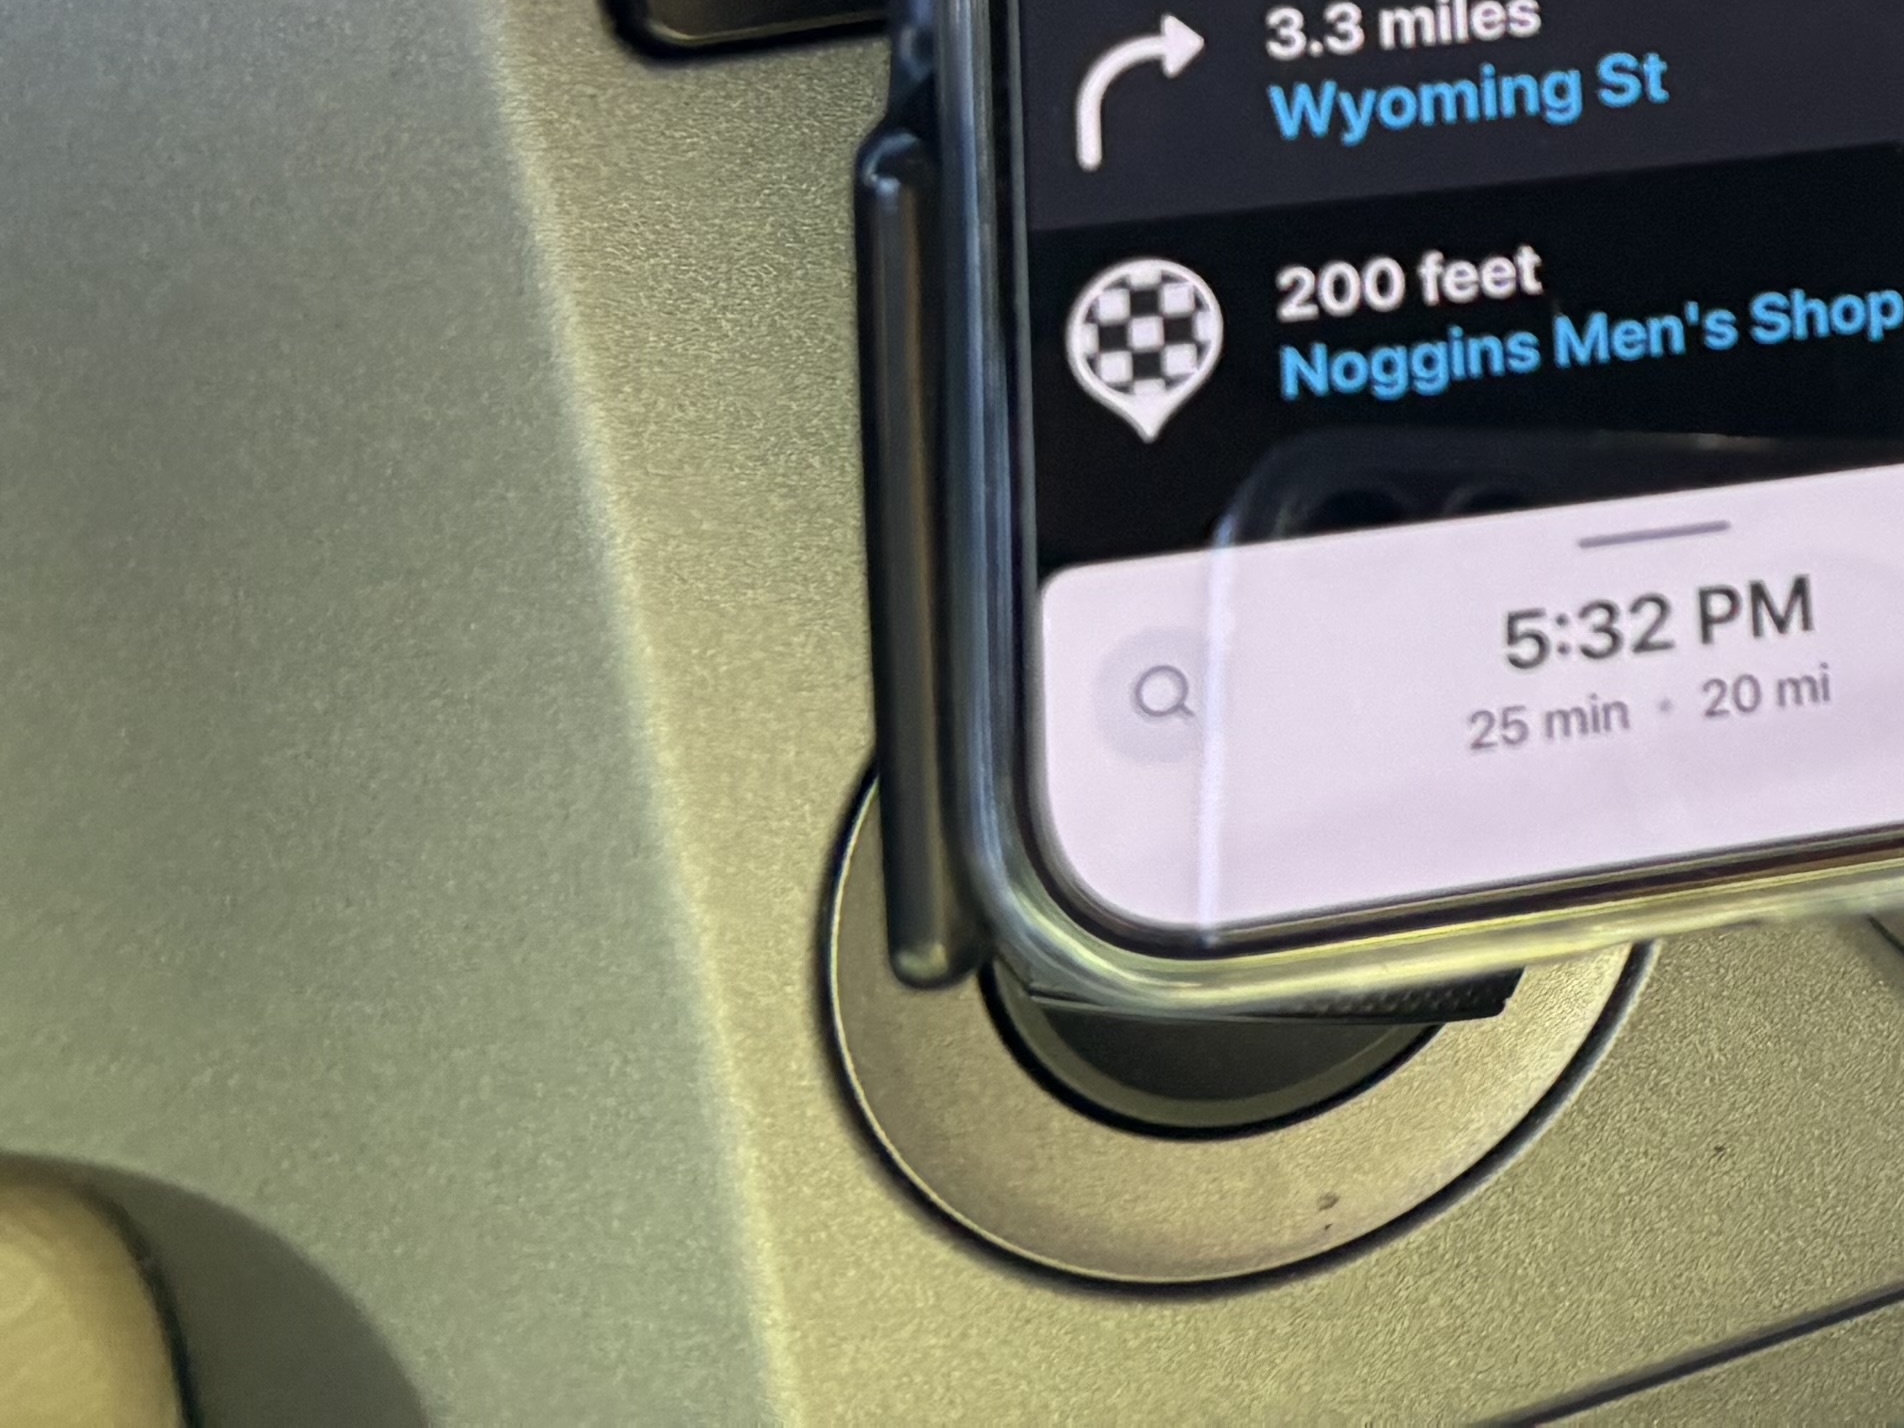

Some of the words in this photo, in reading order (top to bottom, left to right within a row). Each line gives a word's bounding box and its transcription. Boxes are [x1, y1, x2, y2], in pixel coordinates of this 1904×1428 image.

[1267, 1, 1365, 60] 3.3
[1268, 63, 1583, 145] Wyoming
[1597, 52, 1669, 107] St
[1277, 258, 1406, 321] 200
[1417, 245, 1543, 305] feet
[1280, 326, 1541, 400] Noggins
[1553, 301, 1738, 367] Men's
[1750, 289, 1904, 344] Shop
[1505, 593, 1675, 671] 5:32
[1698, 575, 1813, 645] PM
[1467, 705, 1530, 753] 25
[1543, 692, 1631, 740] min
[1701, 673, 1763, 720] 20
[1776, 661, 1831, 709] mi
